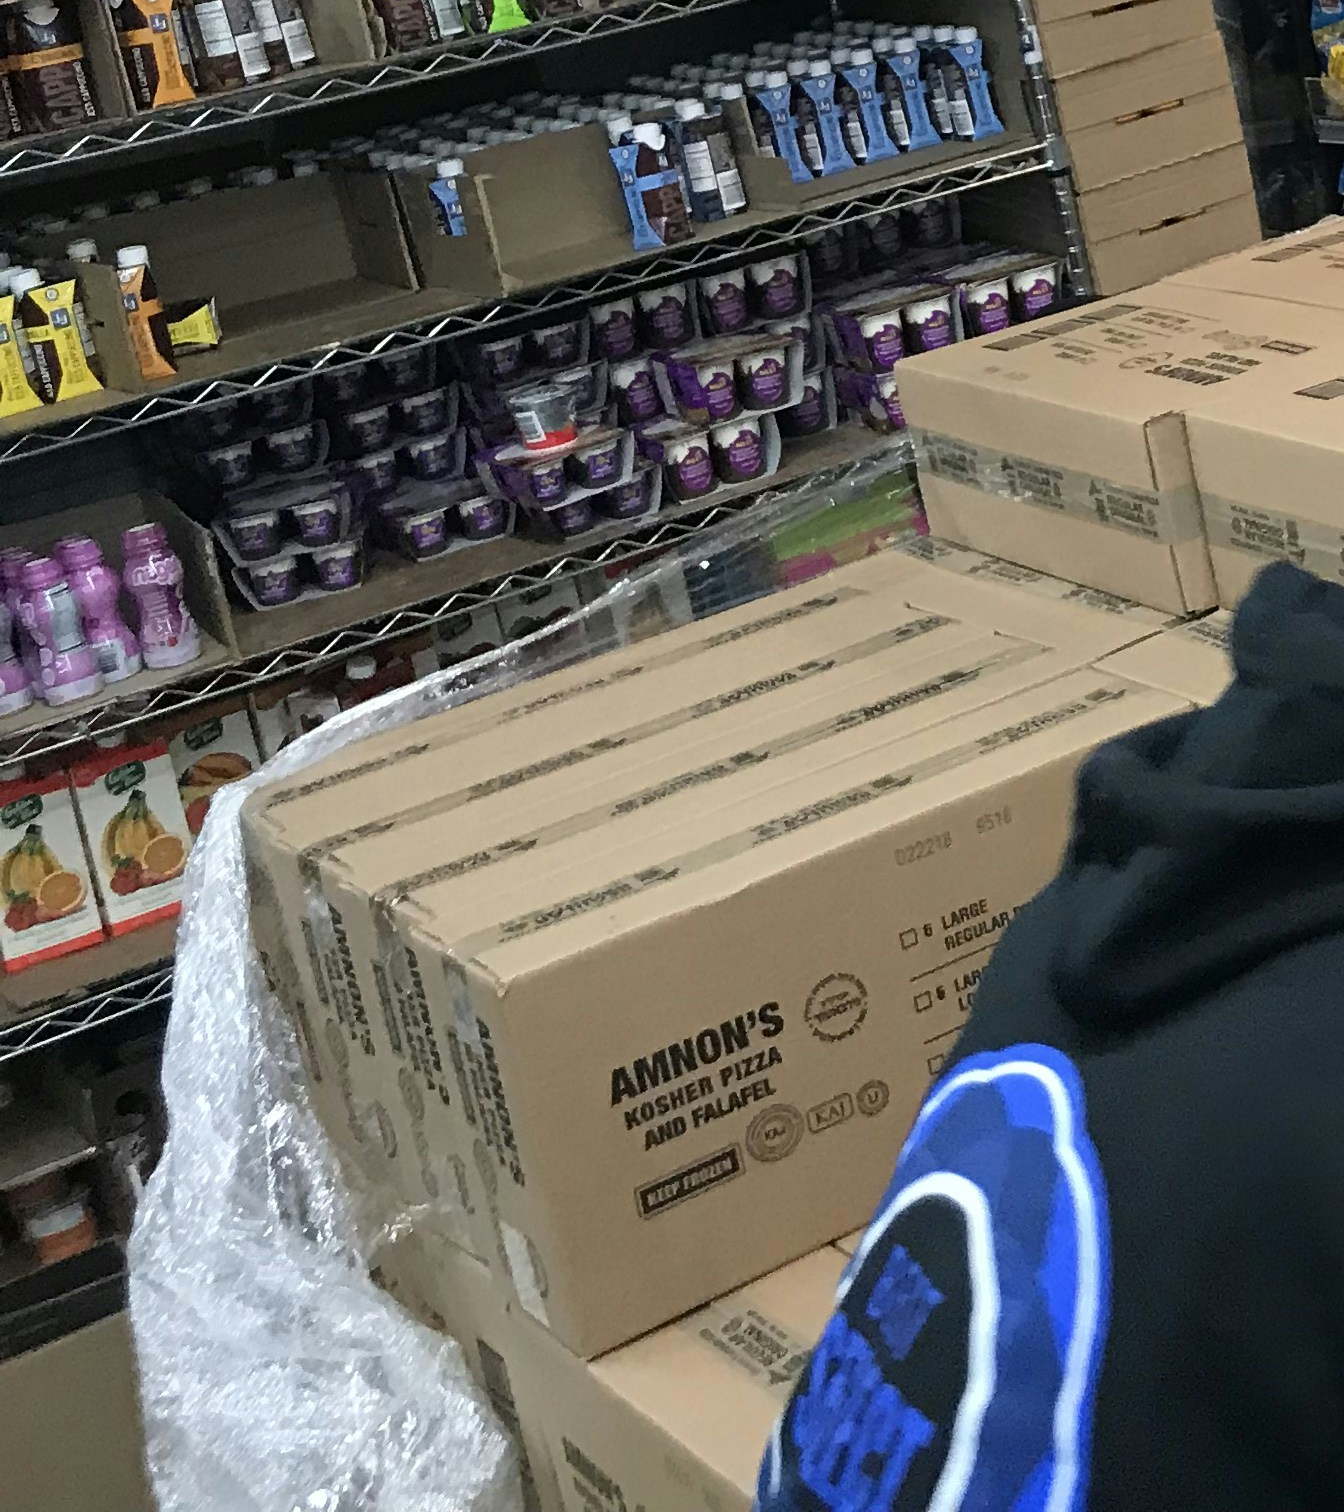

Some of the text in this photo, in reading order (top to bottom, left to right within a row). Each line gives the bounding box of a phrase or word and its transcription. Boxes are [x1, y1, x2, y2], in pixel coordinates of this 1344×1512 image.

[922, 898, 990, 939] 6 LARGE
[944, 912, 1012, 952] REGULAR
[610, 1001, 785, 1107] AMNON'S
[623, 1045, 783, 1131] KOSHER PIZZA
[644, 1077, 777, 1151] AND FALAFEL
